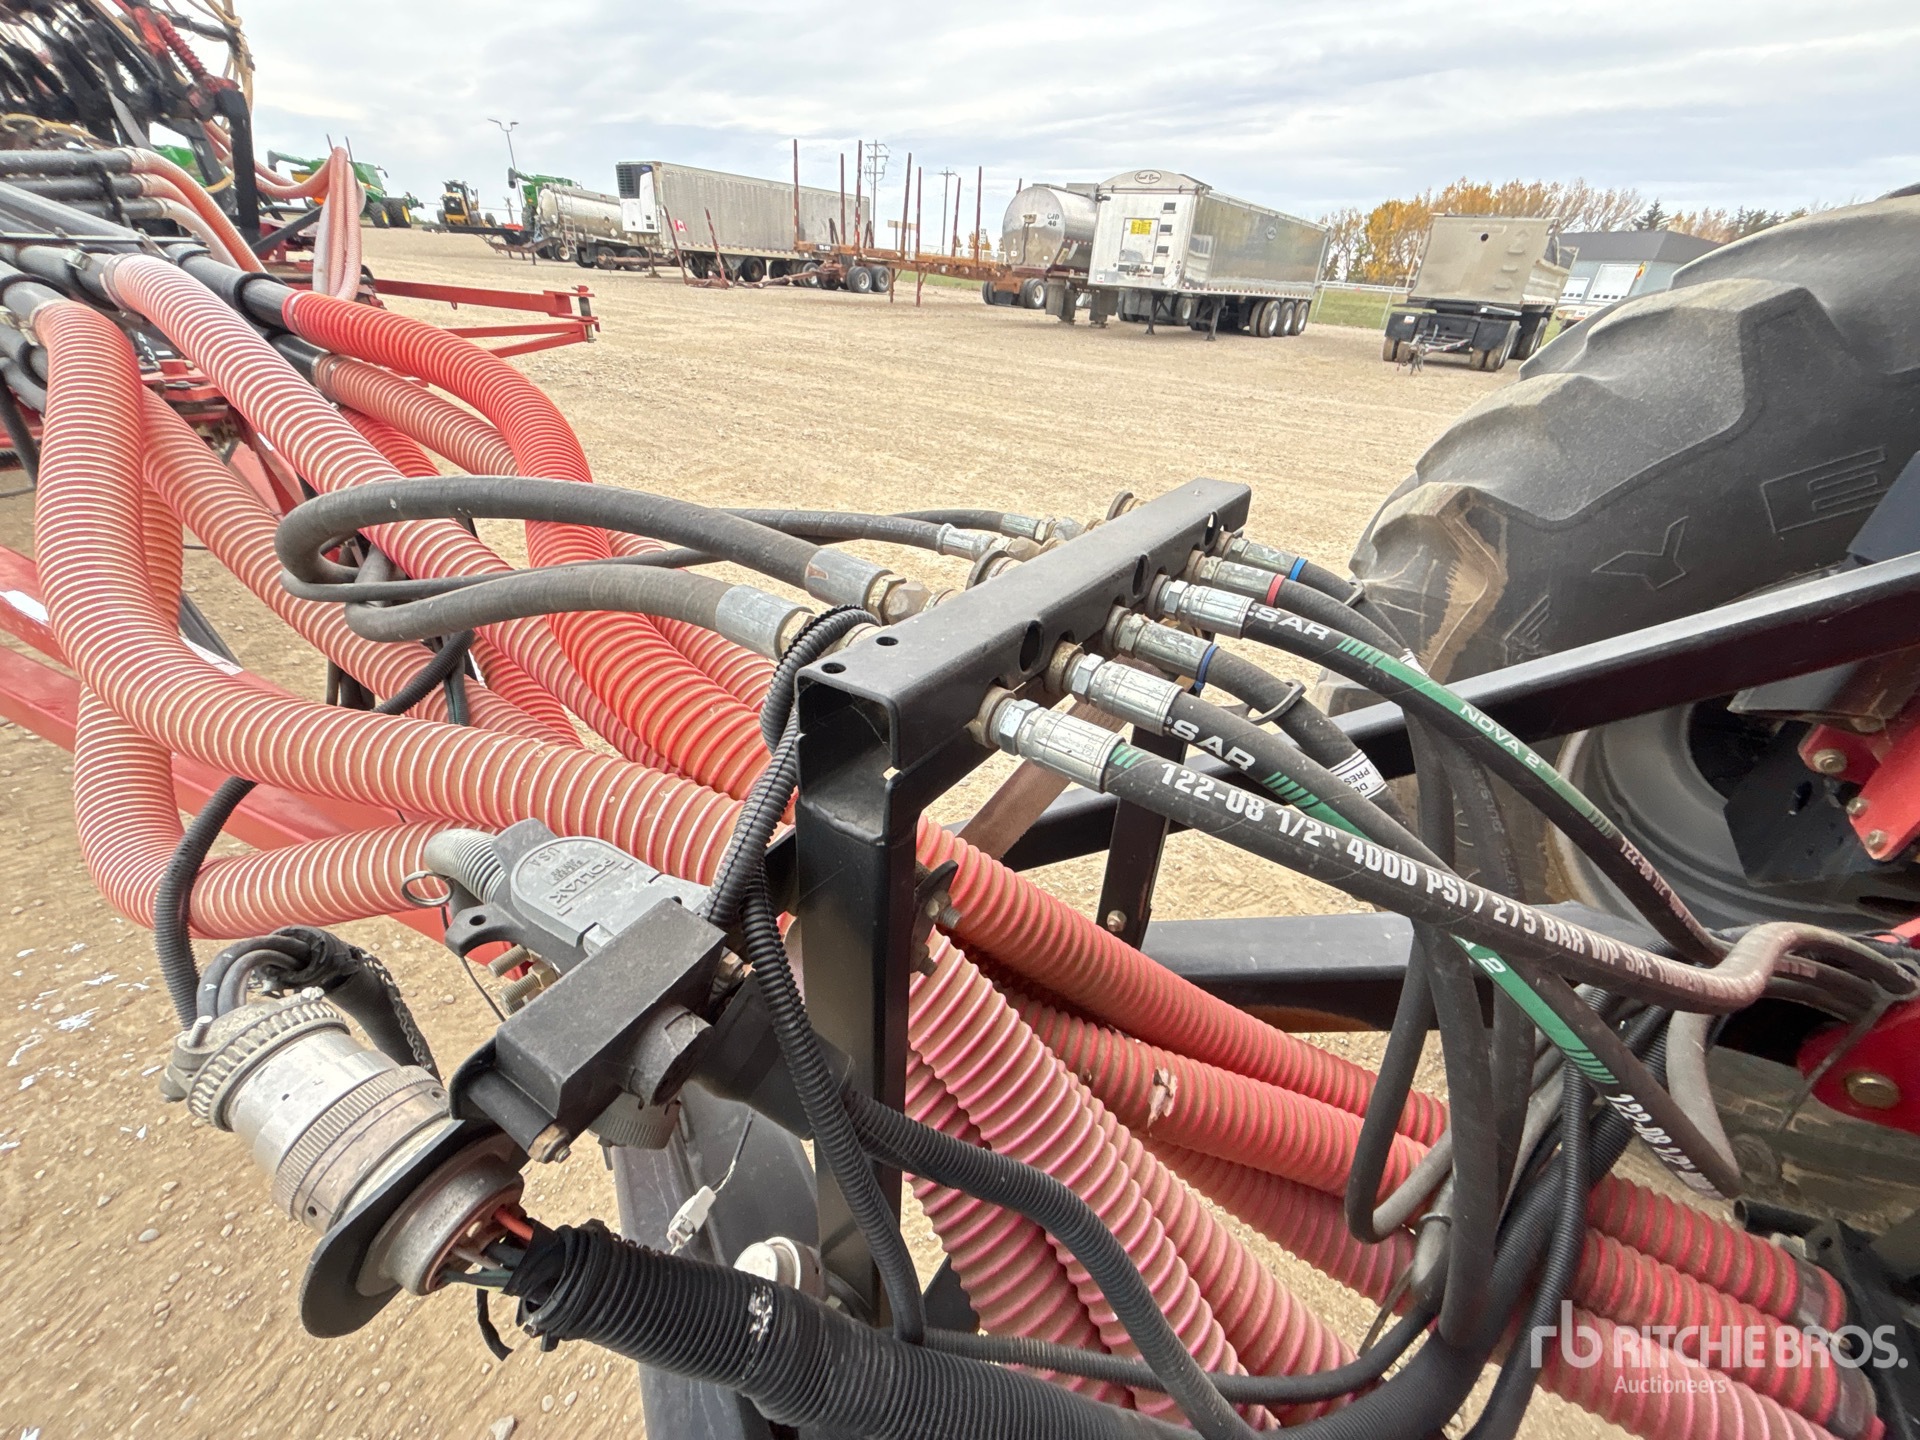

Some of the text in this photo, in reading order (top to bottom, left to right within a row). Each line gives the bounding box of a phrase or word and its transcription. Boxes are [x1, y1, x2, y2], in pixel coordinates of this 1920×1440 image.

[1591, 445, 1892, 591] YE
[1247, 604, 1331, 641] SAR
[1163, 718, 1256, 771] SAR
[1459, 704, 1541, 768] NOVA 2
[1344, 767, 1371, 785] PRES
[549, 857, 617, 905] POLLAK
[1161, 763, 1264, 822] 122-08
[1275, 808, 1337, 847] 1/2"
[1346, 838, 1418, 886] 4000
[1425, 868, 1467, 908] PSI
[1492, 895, 1537, 935] 275
[1540, 915, 1585, 954] BAR
[1586, 932, 1620, 964] WP
[1621, 948, 1653, 979] SAE
[1477, 957, 1507, 974] 2
[1605, 1093, 1673, 1145] 122-08
